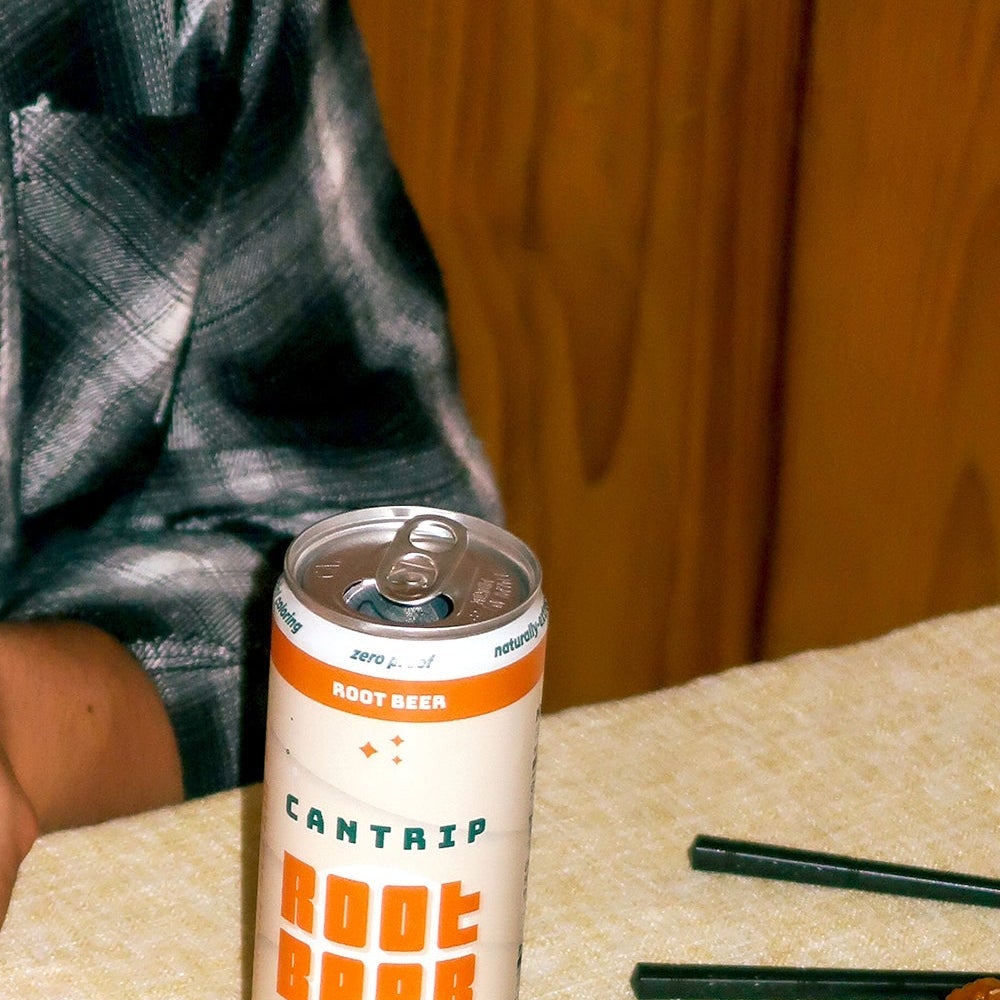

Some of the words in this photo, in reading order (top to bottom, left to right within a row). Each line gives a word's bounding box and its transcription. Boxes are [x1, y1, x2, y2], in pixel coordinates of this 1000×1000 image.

[275, 597, 303, 634] coloring
[349, 648, 386, 665] zero
[332, 680, 387, 708] ROOT
[391, 693, 447, 710] BEER
[285, 793, 487, 850] CANTRIP
